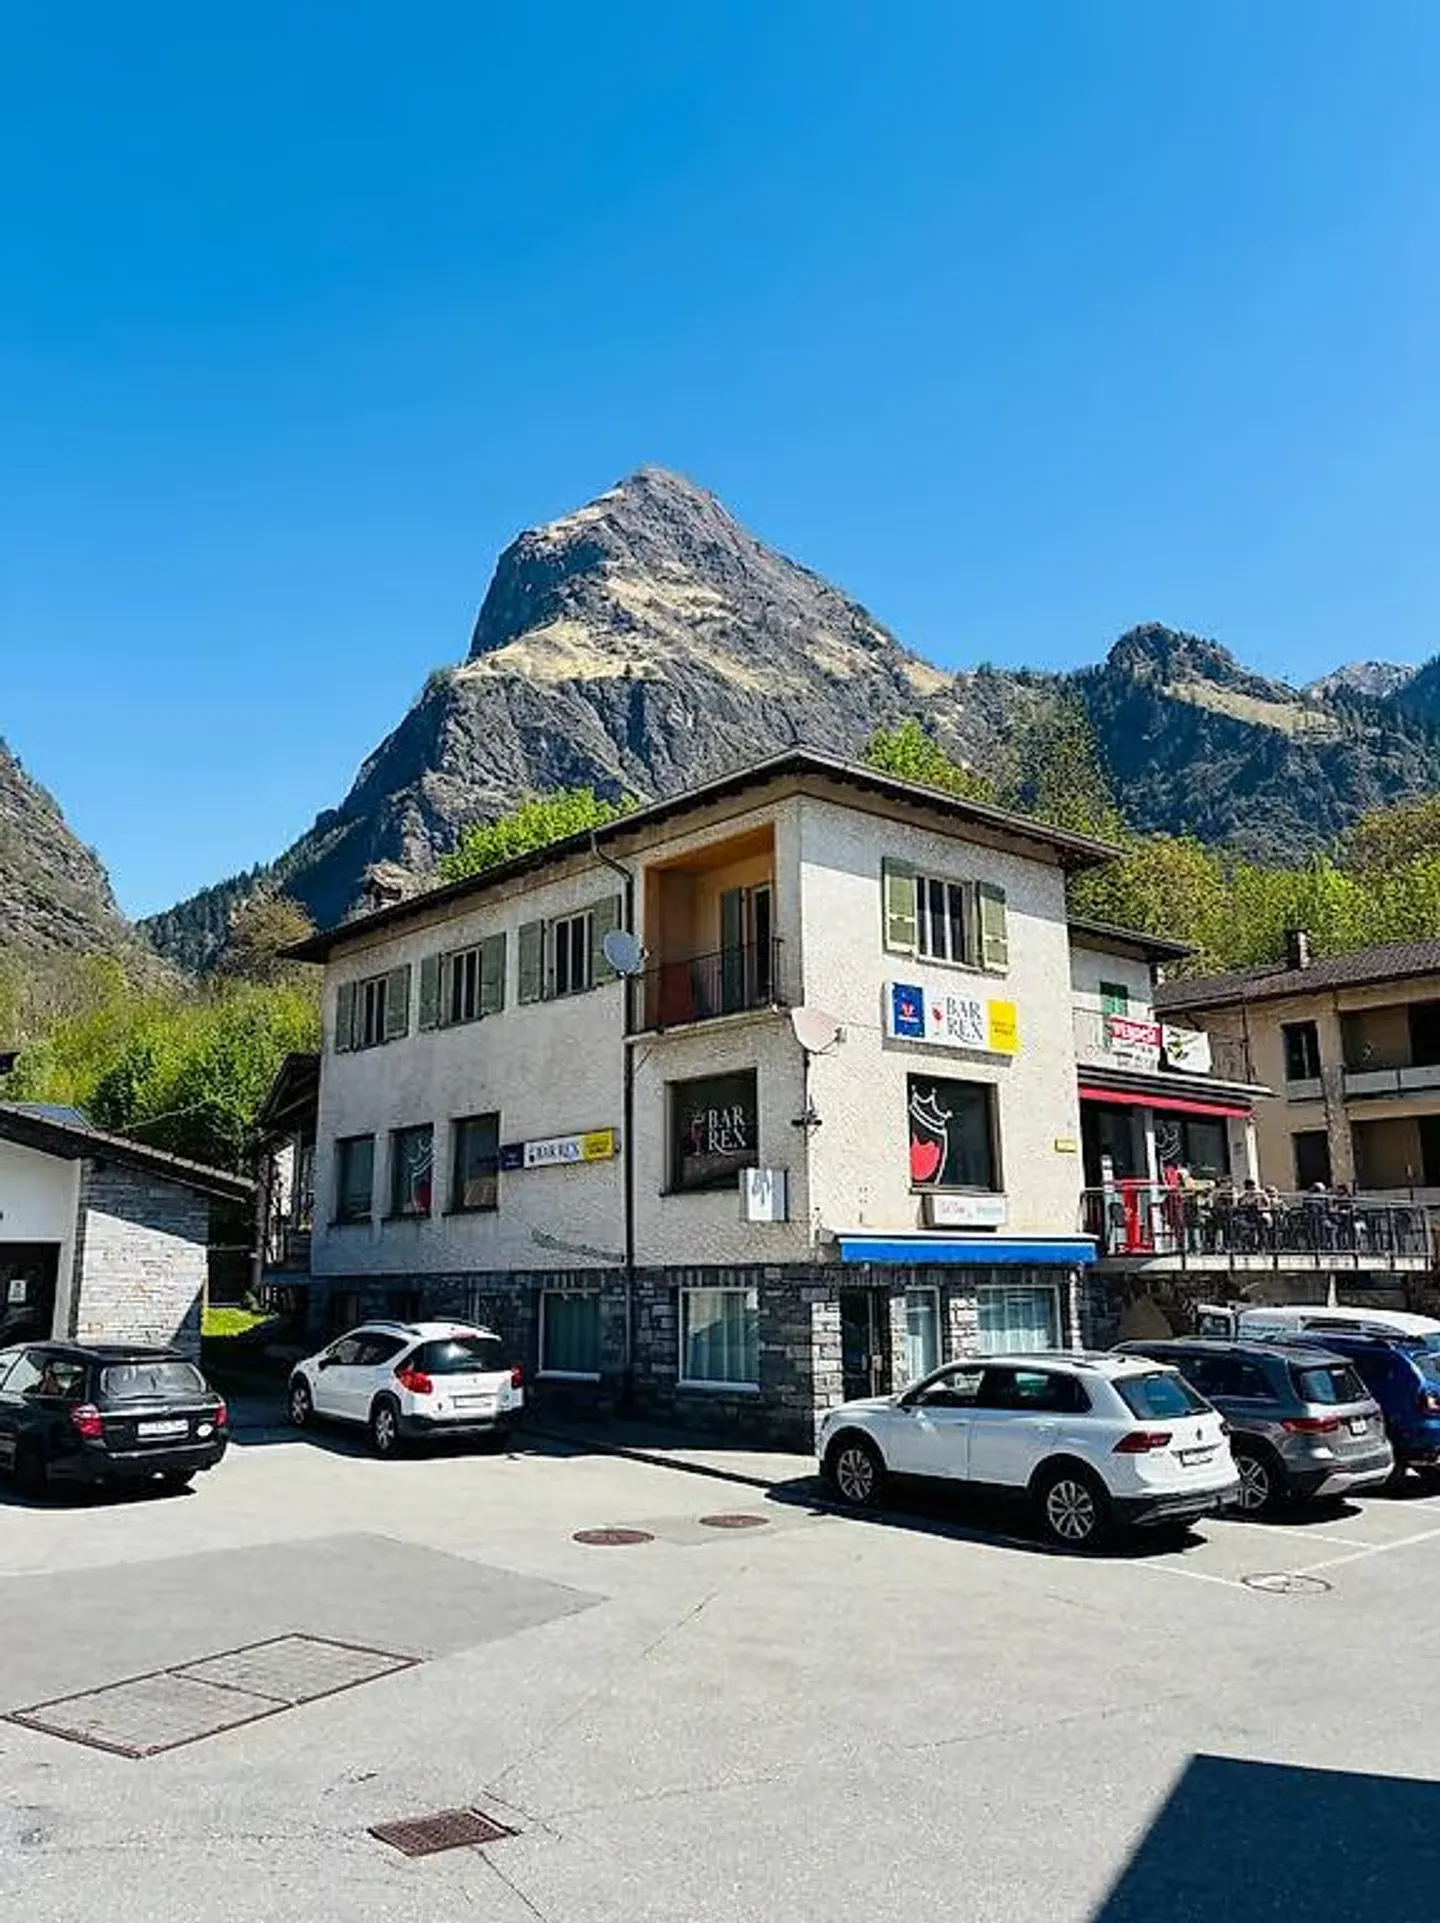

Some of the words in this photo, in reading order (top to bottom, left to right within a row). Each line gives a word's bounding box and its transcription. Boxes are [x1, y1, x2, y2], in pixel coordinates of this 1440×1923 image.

[946, 996, 981, 1020] BAR
[946, 1017, 983, 1045] REX
[708, 1105, 745, 1129] BAR
[708, 1127, 747, 1156] REX
